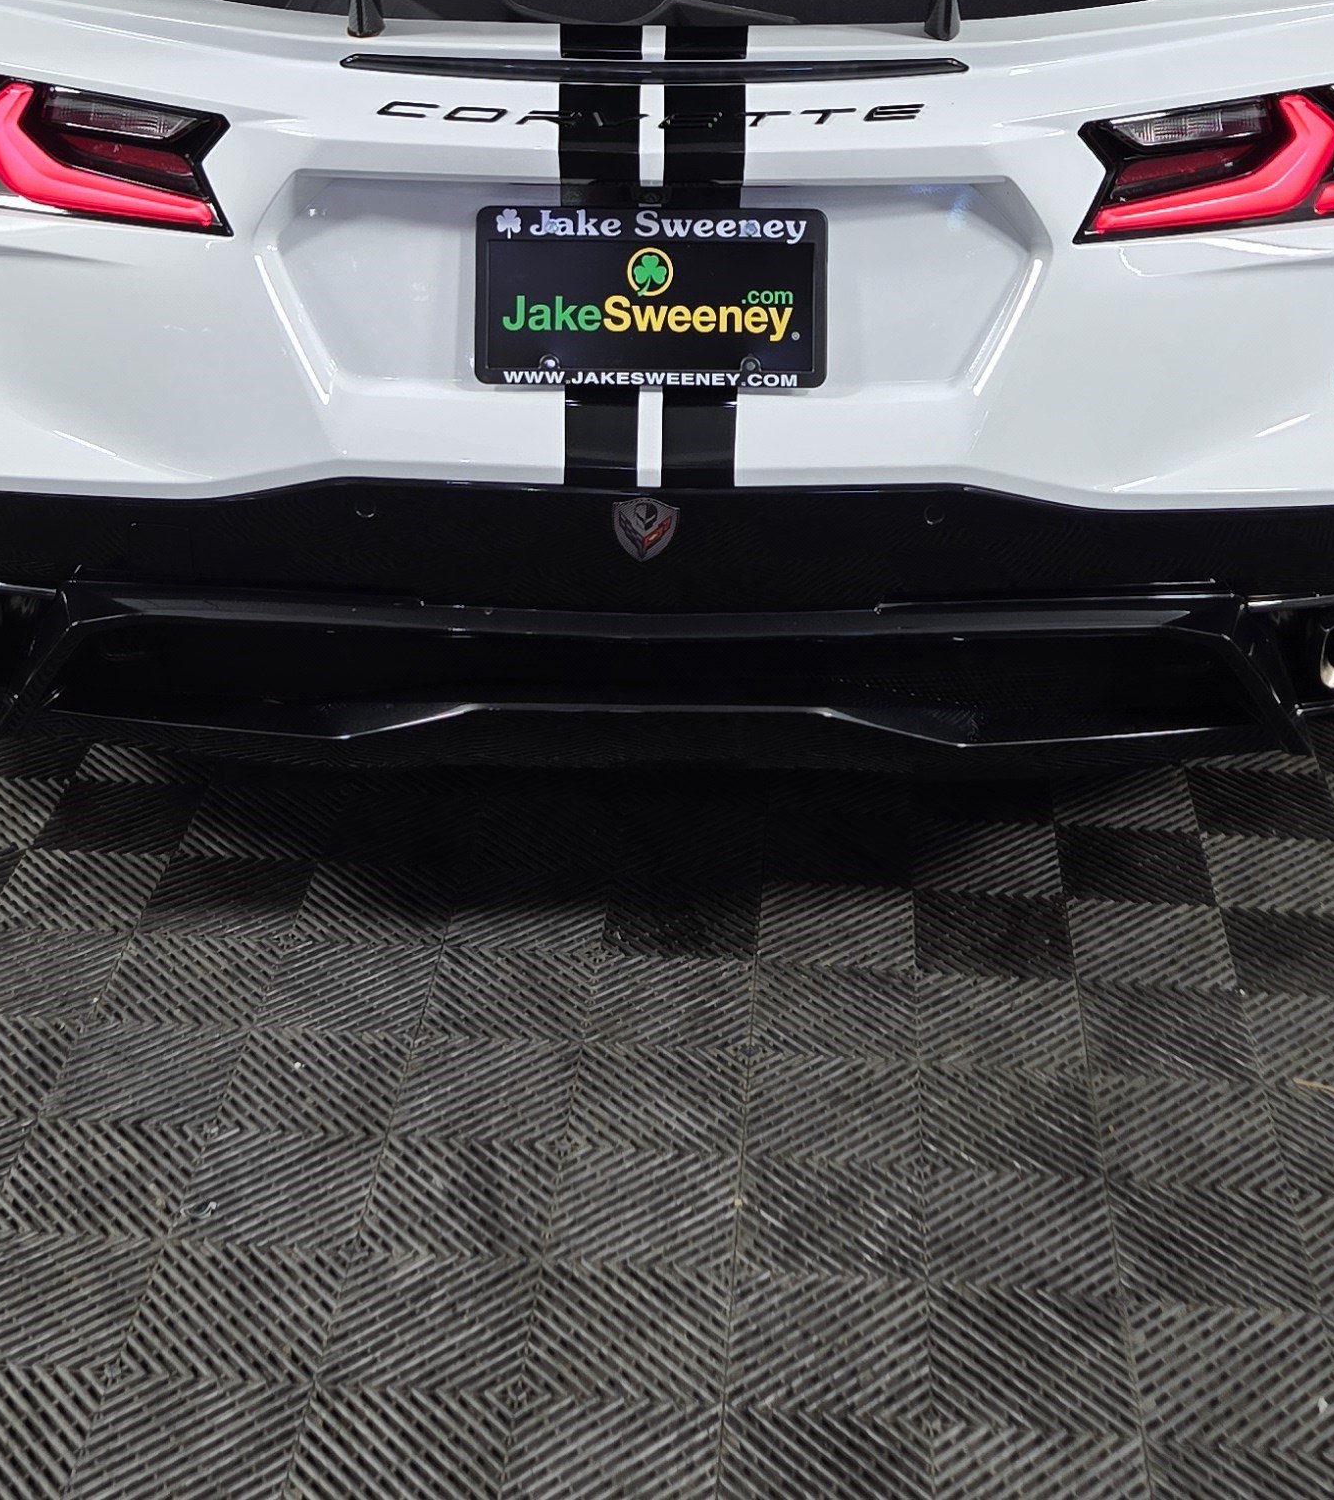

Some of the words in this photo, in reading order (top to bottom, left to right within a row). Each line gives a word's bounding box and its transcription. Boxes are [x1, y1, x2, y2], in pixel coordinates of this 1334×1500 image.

[375, 100, 924, 129] CORVETTE
[530, 209, 621, 237] Jake
[635, 210, 807, 244] Sweeney
[741, 289, 794, 305] .com
[503, 294, 793, 342] JakeSweeney
[503, 371, 798, 387] WWW.JAKESWEENEY.COM
